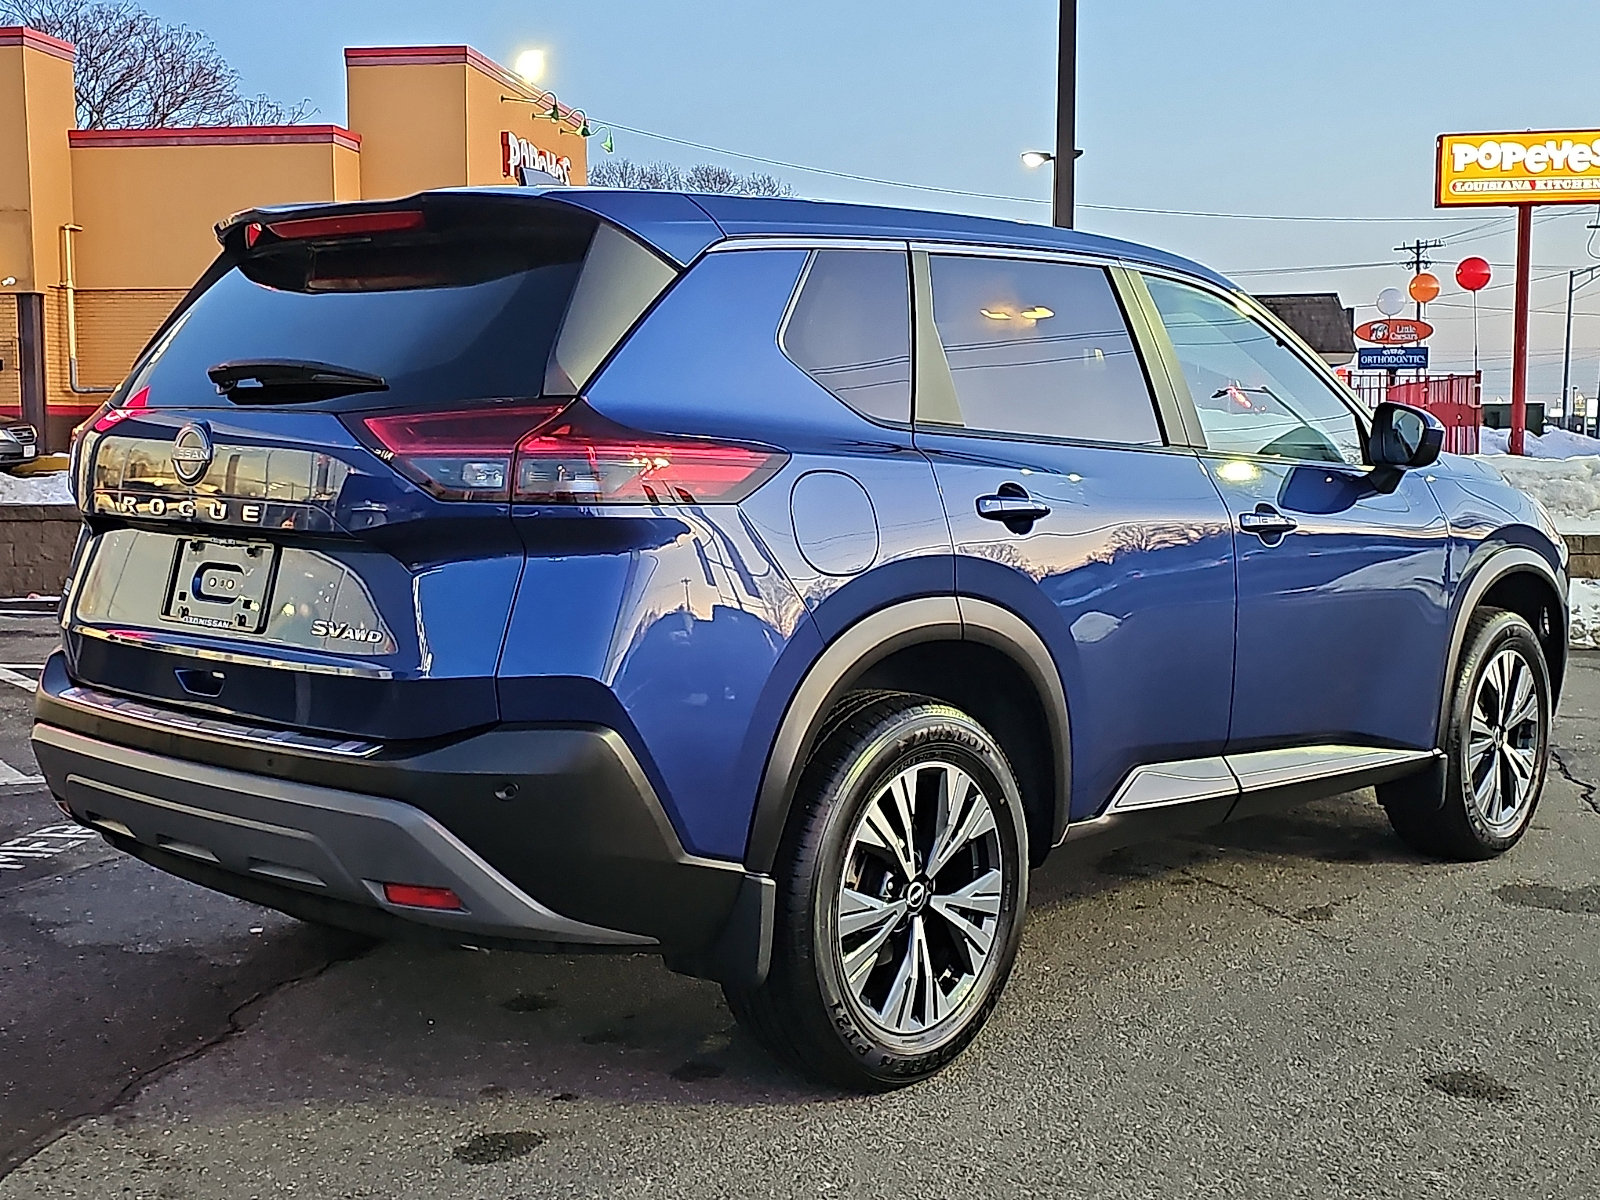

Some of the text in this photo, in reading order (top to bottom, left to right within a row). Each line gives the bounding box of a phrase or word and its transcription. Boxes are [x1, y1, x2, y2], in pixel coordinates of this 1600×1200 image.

[1454, 179, 1533, 193] LOUISIANA
[120, 496, 261, 523] ROGUE
[310, 619, 383, 643] SV AWD
